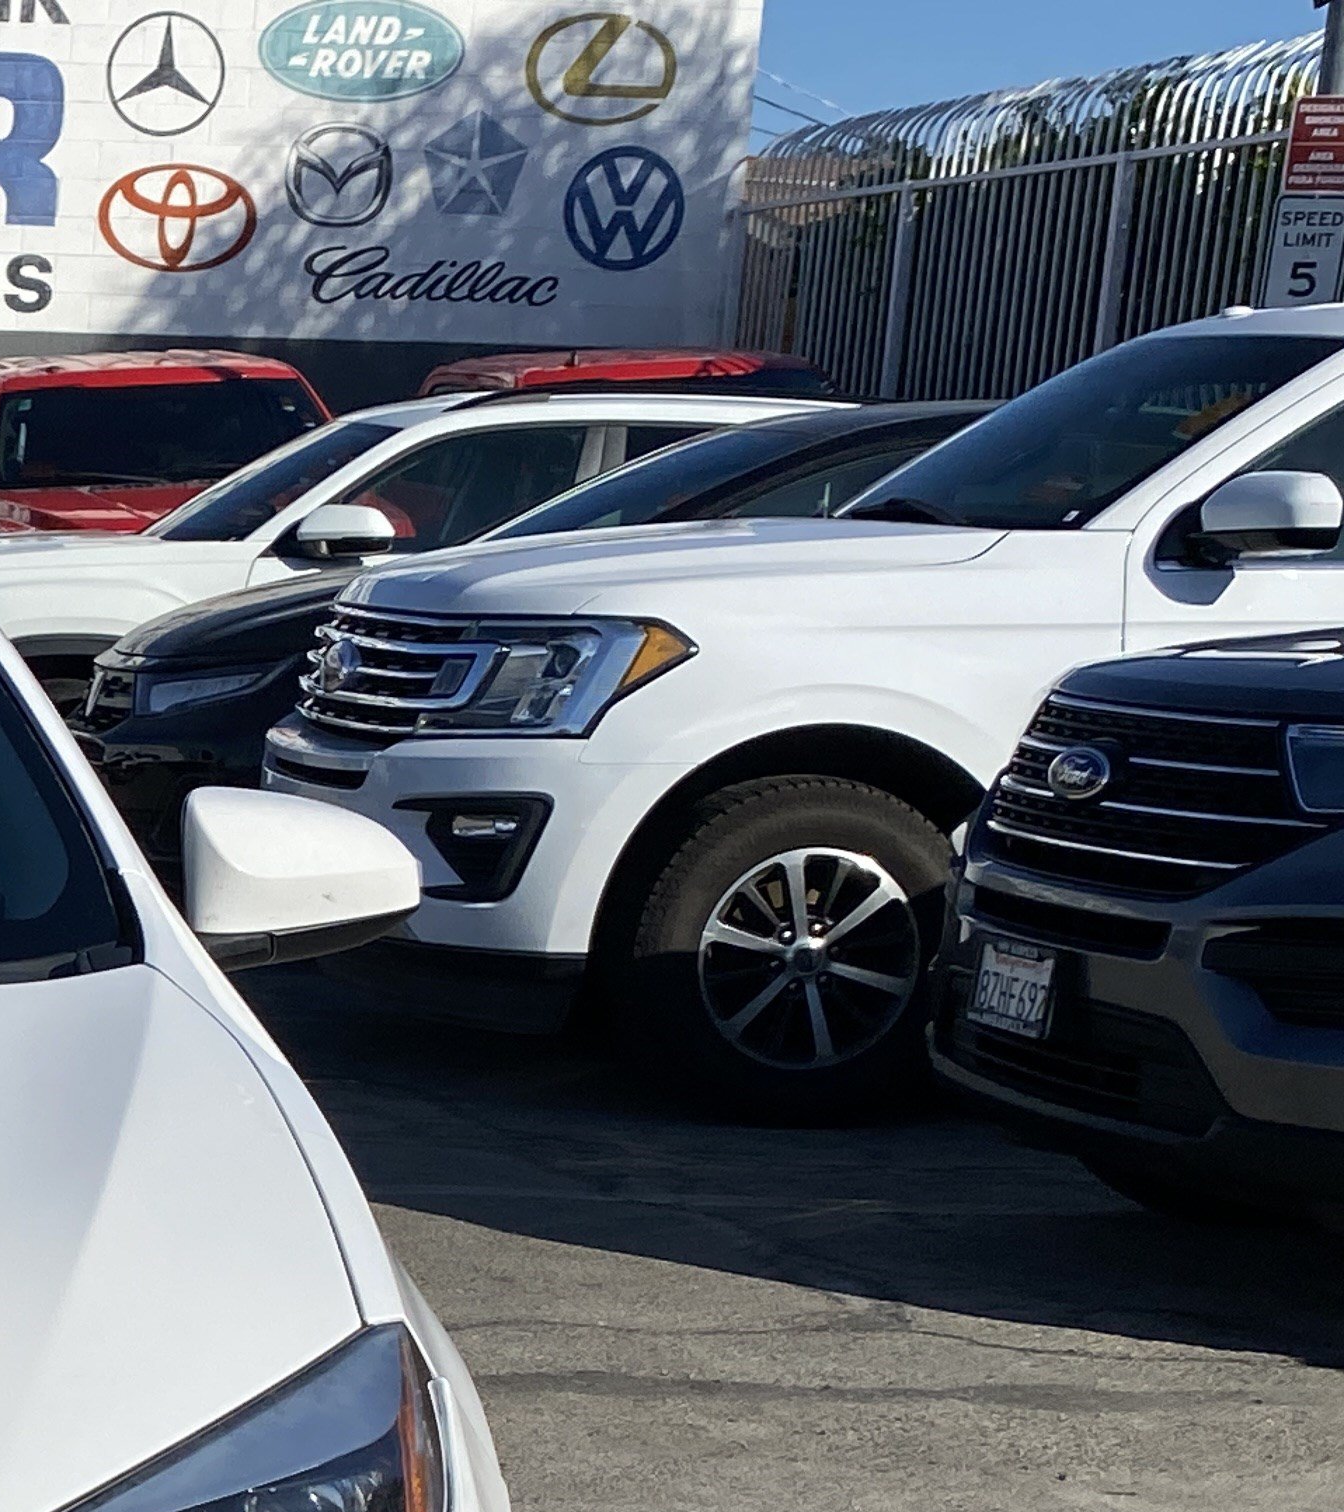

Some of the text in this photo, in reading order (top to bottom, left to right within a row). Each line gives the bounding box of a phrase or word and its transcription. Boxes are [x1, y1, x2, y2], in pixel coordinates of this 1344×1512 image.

[1280, 211, 1344, 227] SPEED
[1283, 231, 1335, 248] LIMIT
[303, 245, 560, 307] Cadillac
[1287, 261, 1318, 297] 5
